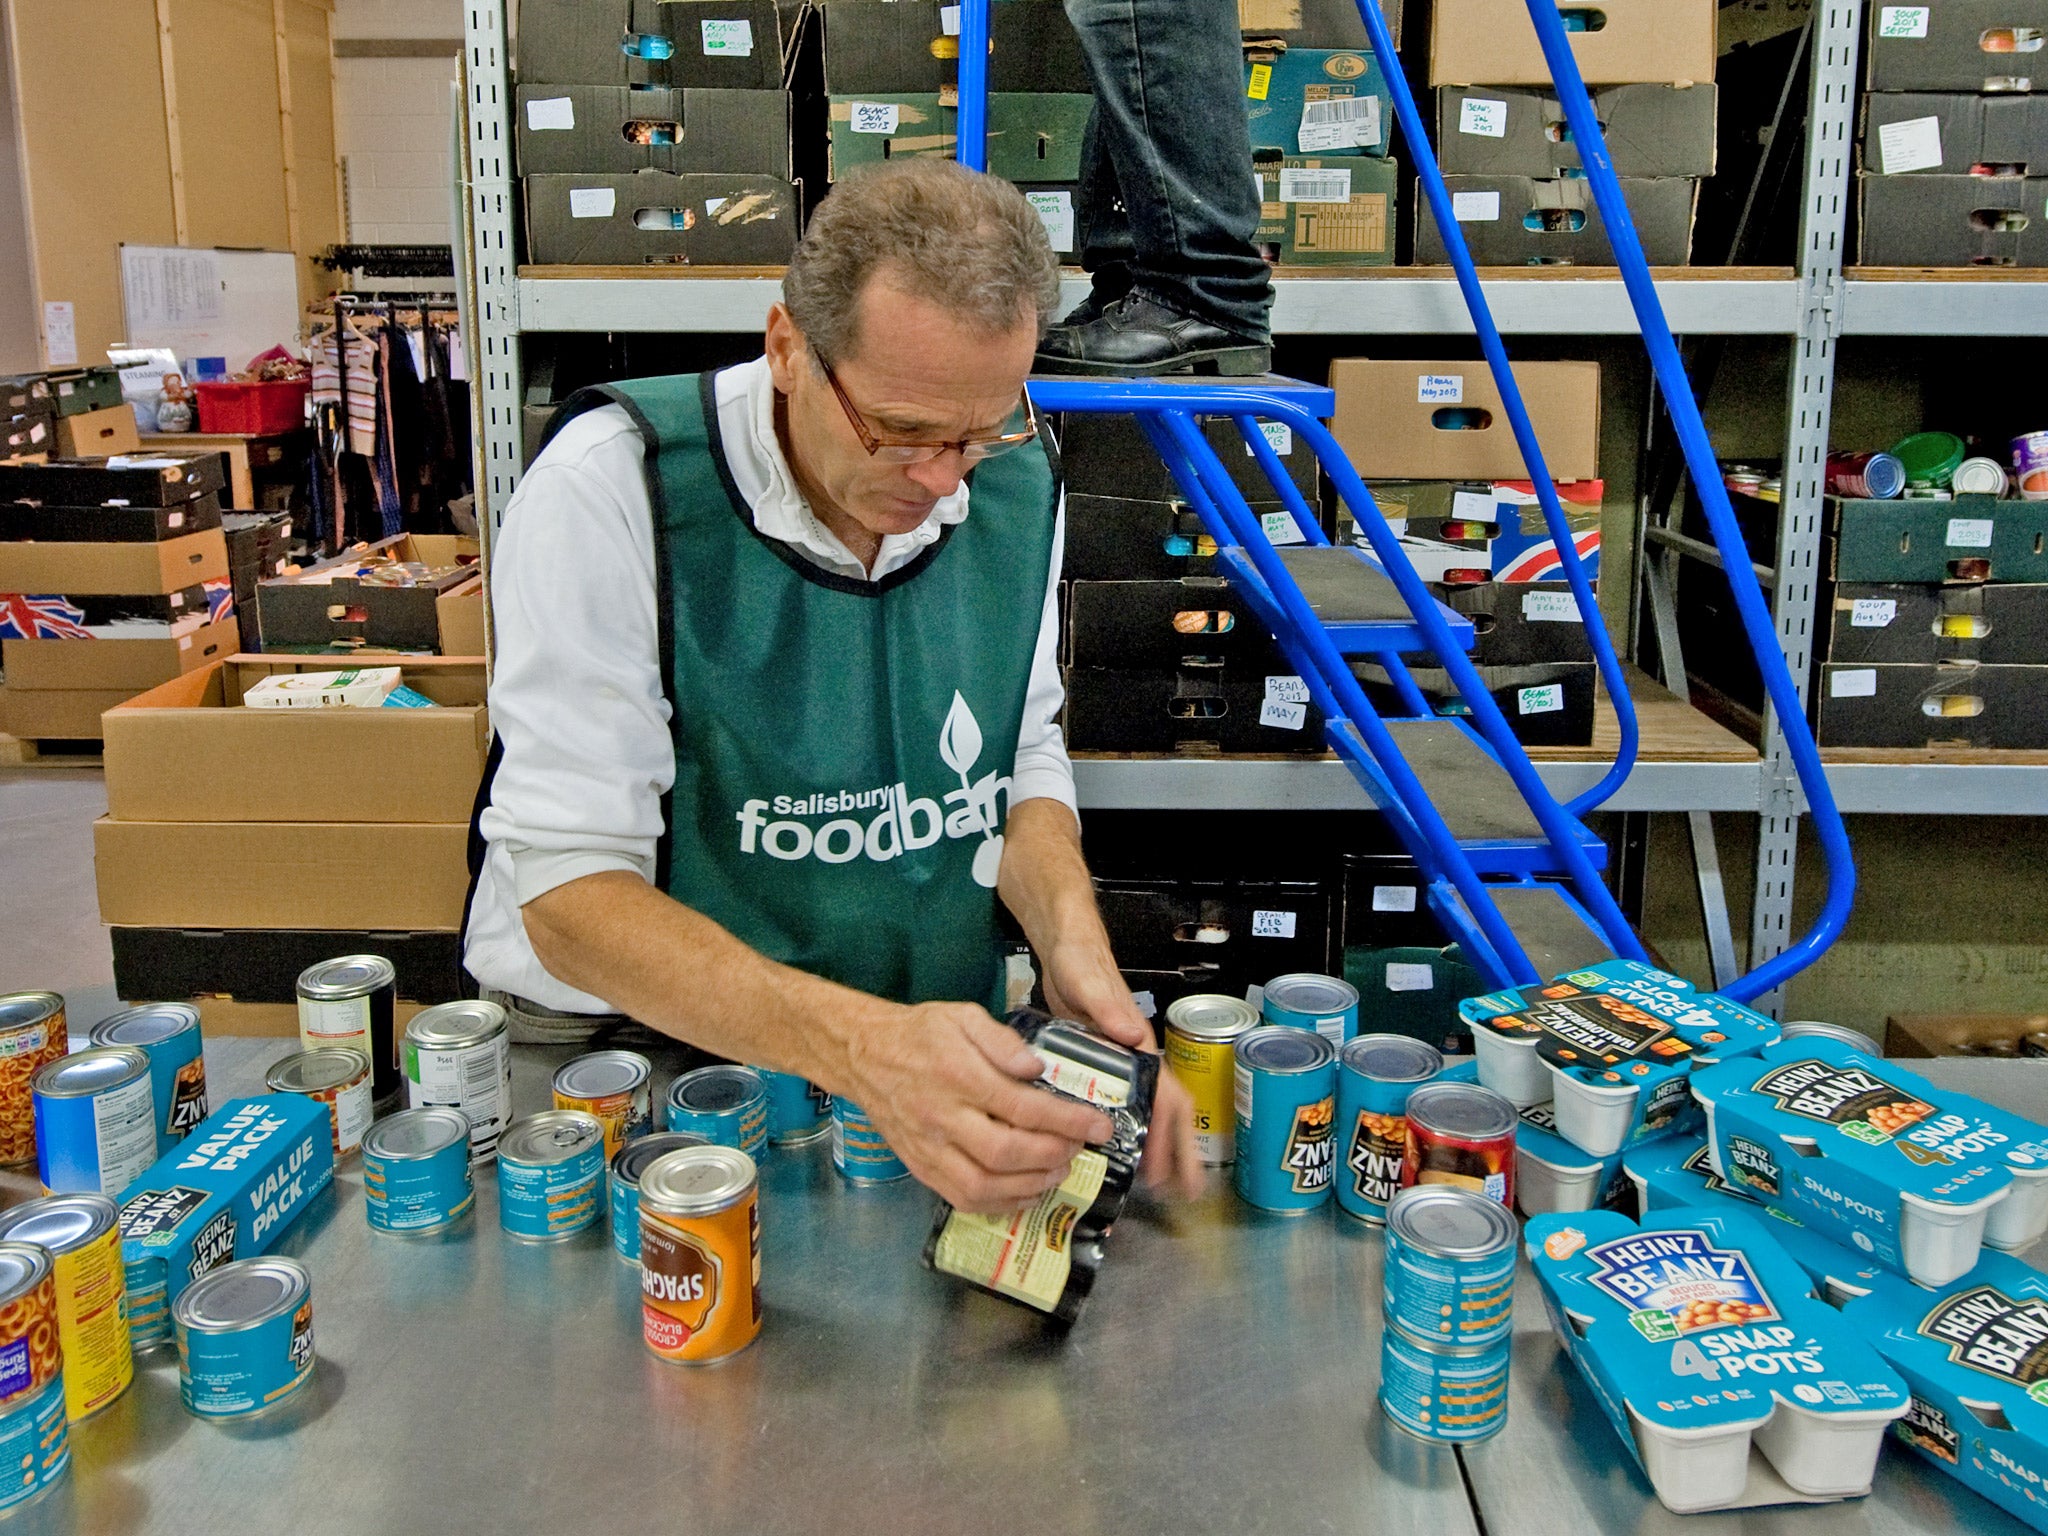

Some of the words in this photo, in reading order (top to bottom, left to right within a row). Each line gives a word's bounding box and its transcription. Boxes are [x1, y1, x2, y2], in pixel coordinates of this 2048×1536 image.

[1893, 10, 1921, 20] SOUP
[1884, 26, 1912, 36] SEPT
[858, 106, 891, 116] BEANS
[860, 122, 890, 131] 2013
[1262, 425, 1287, 434] ANS
[1859, 602, 1887, 610] SOUP
[1270, 678, 1306, 692] BEANS
[1279, 692, 1302, 702] 2013
[1522, 688, 1553, 701] BEANS
[1267, 704, 1298, 721] MAY
[772, 785, 892, 815] Salisbury
[1607, 987, 1683, 1018] SNAP
[1627, 979, 1697, 1010] POTS
[1536, 1012, 1606, 1050] HEINZ
[1675, 1009, 1720, 1027] 4
[1766, 1064, 1835, 1096] HEINZ
[1790, 1073, 1885, 1118] BEANZ
[176, 1104, 270, 1170] VALUE
[1908, 1114, 1970, 1147] SNAP
[1937, 1128, 2010, 1160] POTS
[1731, 1150, 1779, 1180] BEANZ
[1734, 1139, 1770, 1161] HEINZ
[1893, 1139, 1956, 1167] 4
[250, 1136, 314, 1211] VALUE
[127, 1190, 192, 1237] BEANZ
[1803, 1176, 1843, 1203] SNAP
[1844, 1196, 1885, 1223] POTS
[197, 1214, 229, 1254] HEINZ
[192, 1231, 235, 1279] BEANZ
[1605, 1236, 1701, 1268] HEINZ
[1607, 1257, 1745, 1299] BEANZ
[1668, 1282, 1717, 1297] REDUCED
[1693, 1290, 1714, 1300] AND
[1715, 1288, 1738, 1297] SALT
[1935, 1294, 2013, 1342] HEINZ
[1700, 1326, 1796, 1356] SNAP
[1670, 1339, 1722, 1381] 4
[1718, 1350, 1825, 1378] POTS
[1989, 1448, 2041, 1484] SNAP
